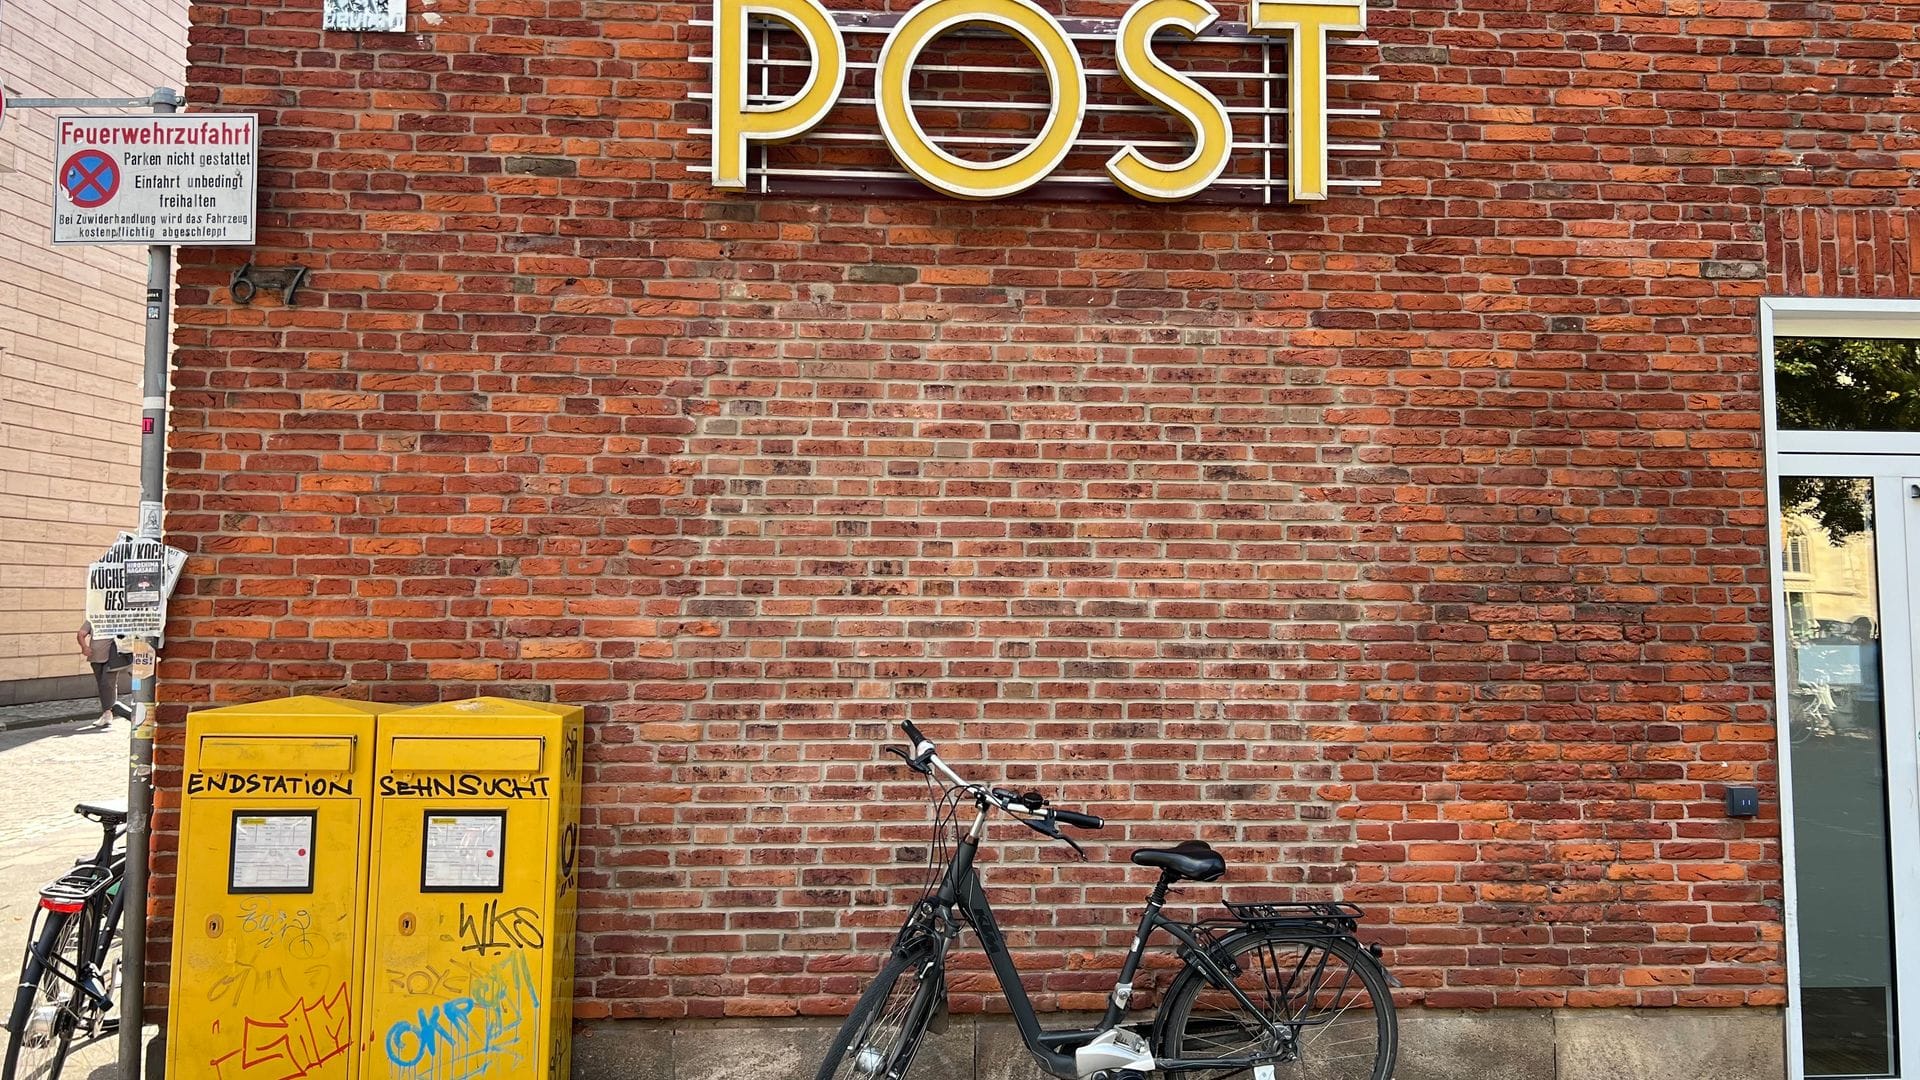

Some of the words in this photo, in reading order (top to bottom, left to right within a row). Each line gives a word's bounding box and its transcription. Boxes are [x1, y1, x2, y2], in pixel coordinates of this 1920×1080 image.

[712, 0, 1367, 202] POST
[61, 121, 251, 145] Feuerwehrzufahrt
[124, 152, 161, 166] Parken
[167, 152, 195, 166] nicht
[200, 152, 250, 167] gestattet
[135, 175, 180, 189] Einfahrt
[188, 174, 243, 190] unbedingt
[160, 194, 216, 208] freihalten
[59, 214, 73, 225] Bei
[76, 214, 156, 226] Zuwiderhandlung
[161, 214, 182, 224] wird
[186, 214, 202, 224] das
[206, 214, 248, 225] Fahrzeug
[79, 226, 155, 238] kostenpflichtig
[162, 226, 226, 238] abgeschleppt
